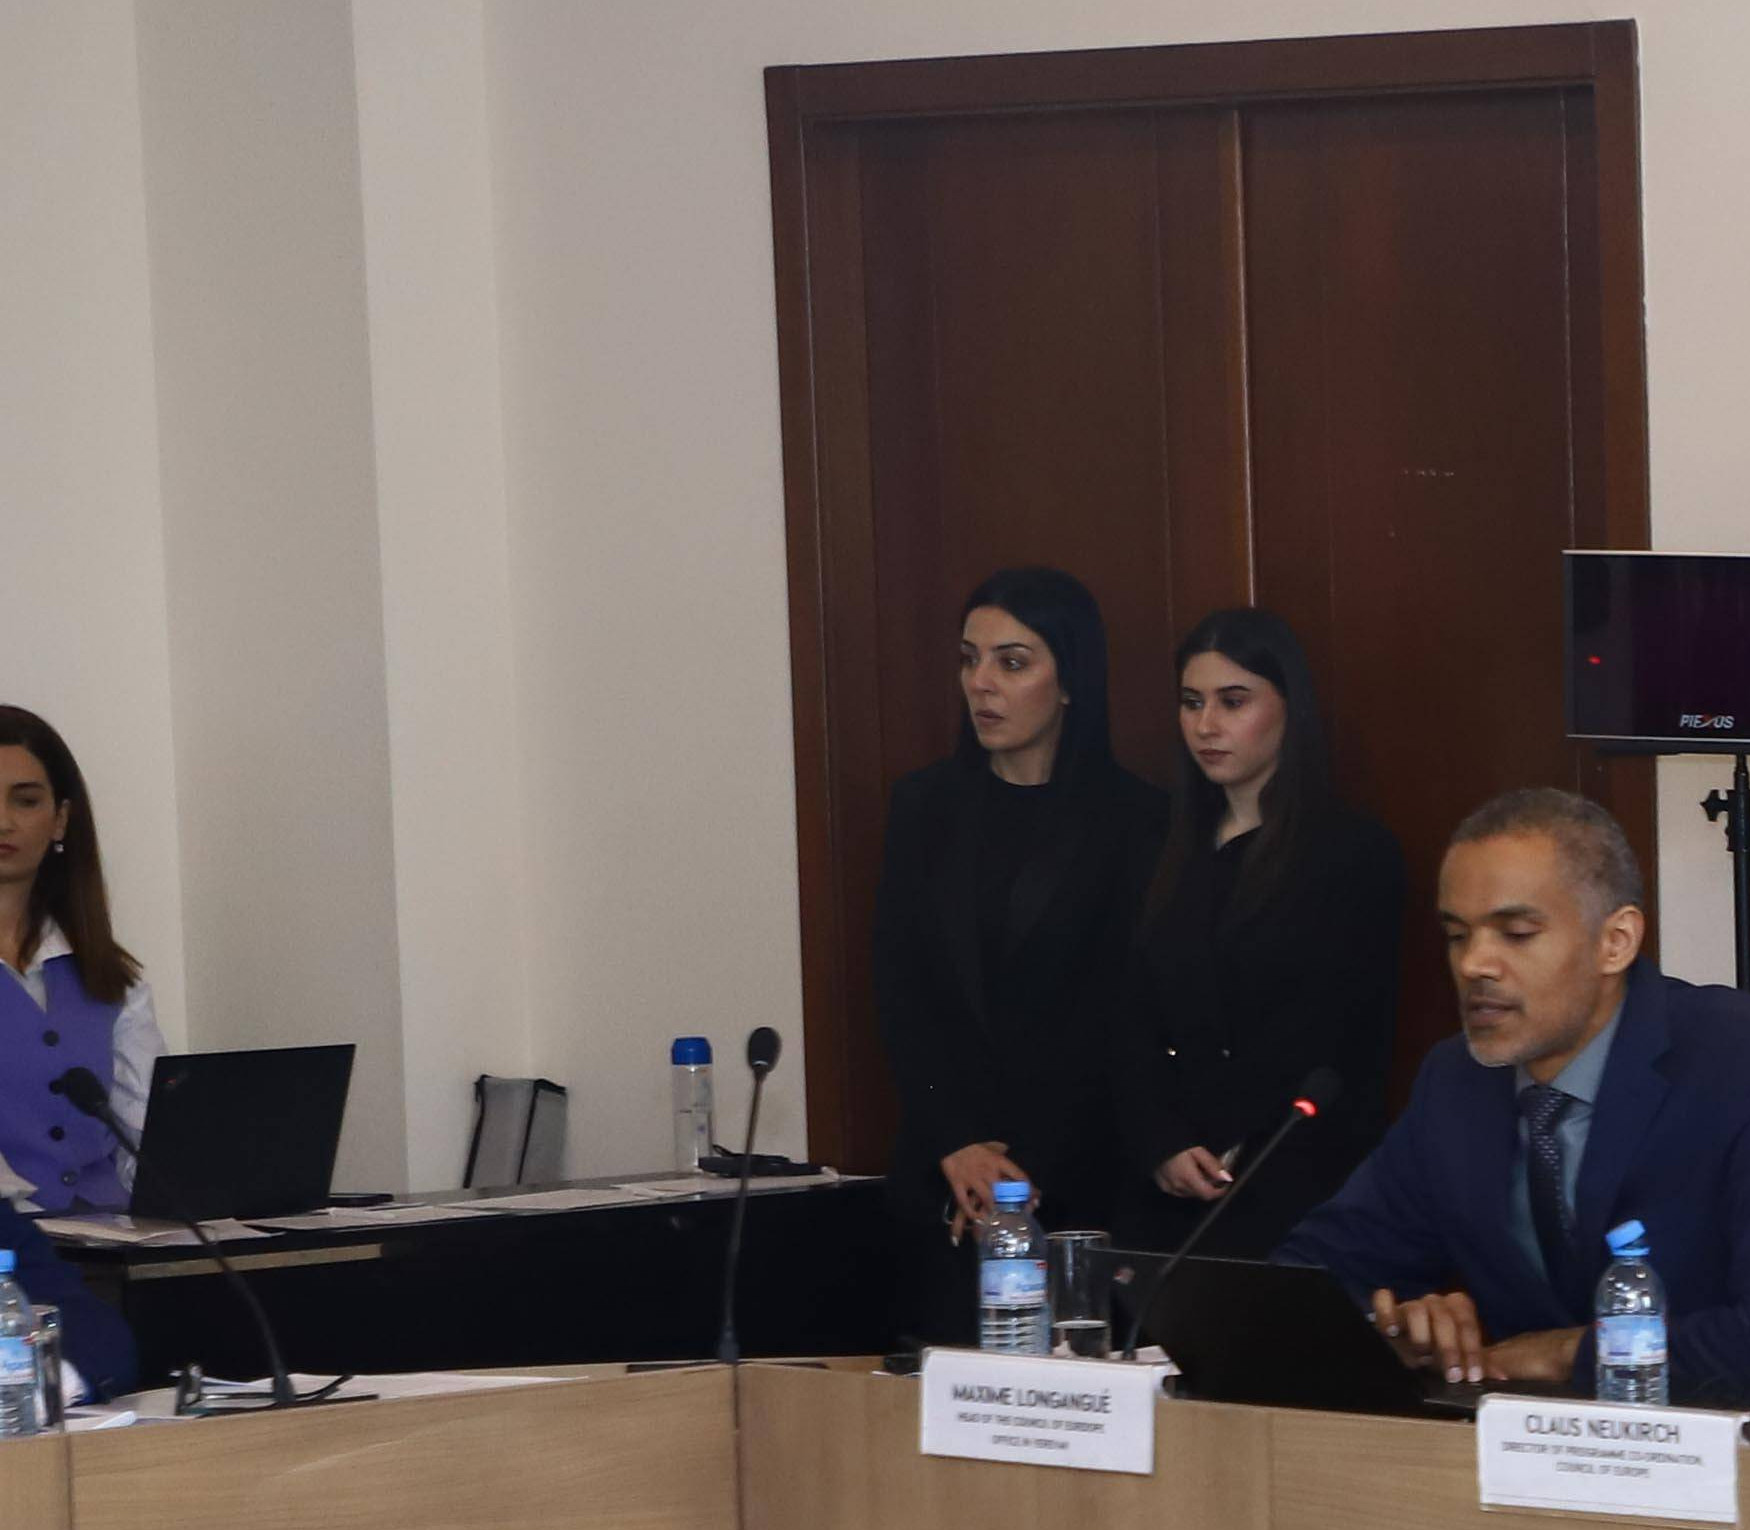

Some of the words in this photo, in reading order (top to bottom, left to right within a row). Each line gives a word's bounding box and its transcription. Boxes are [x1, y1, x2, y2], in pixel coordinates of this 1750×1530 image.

[951, 1382, 1012, 1405] MAXIME
[1525, 1413, 1582, 1438] CLAUS
[1586, 1418, 1682, 1445] NEUKIRCH
